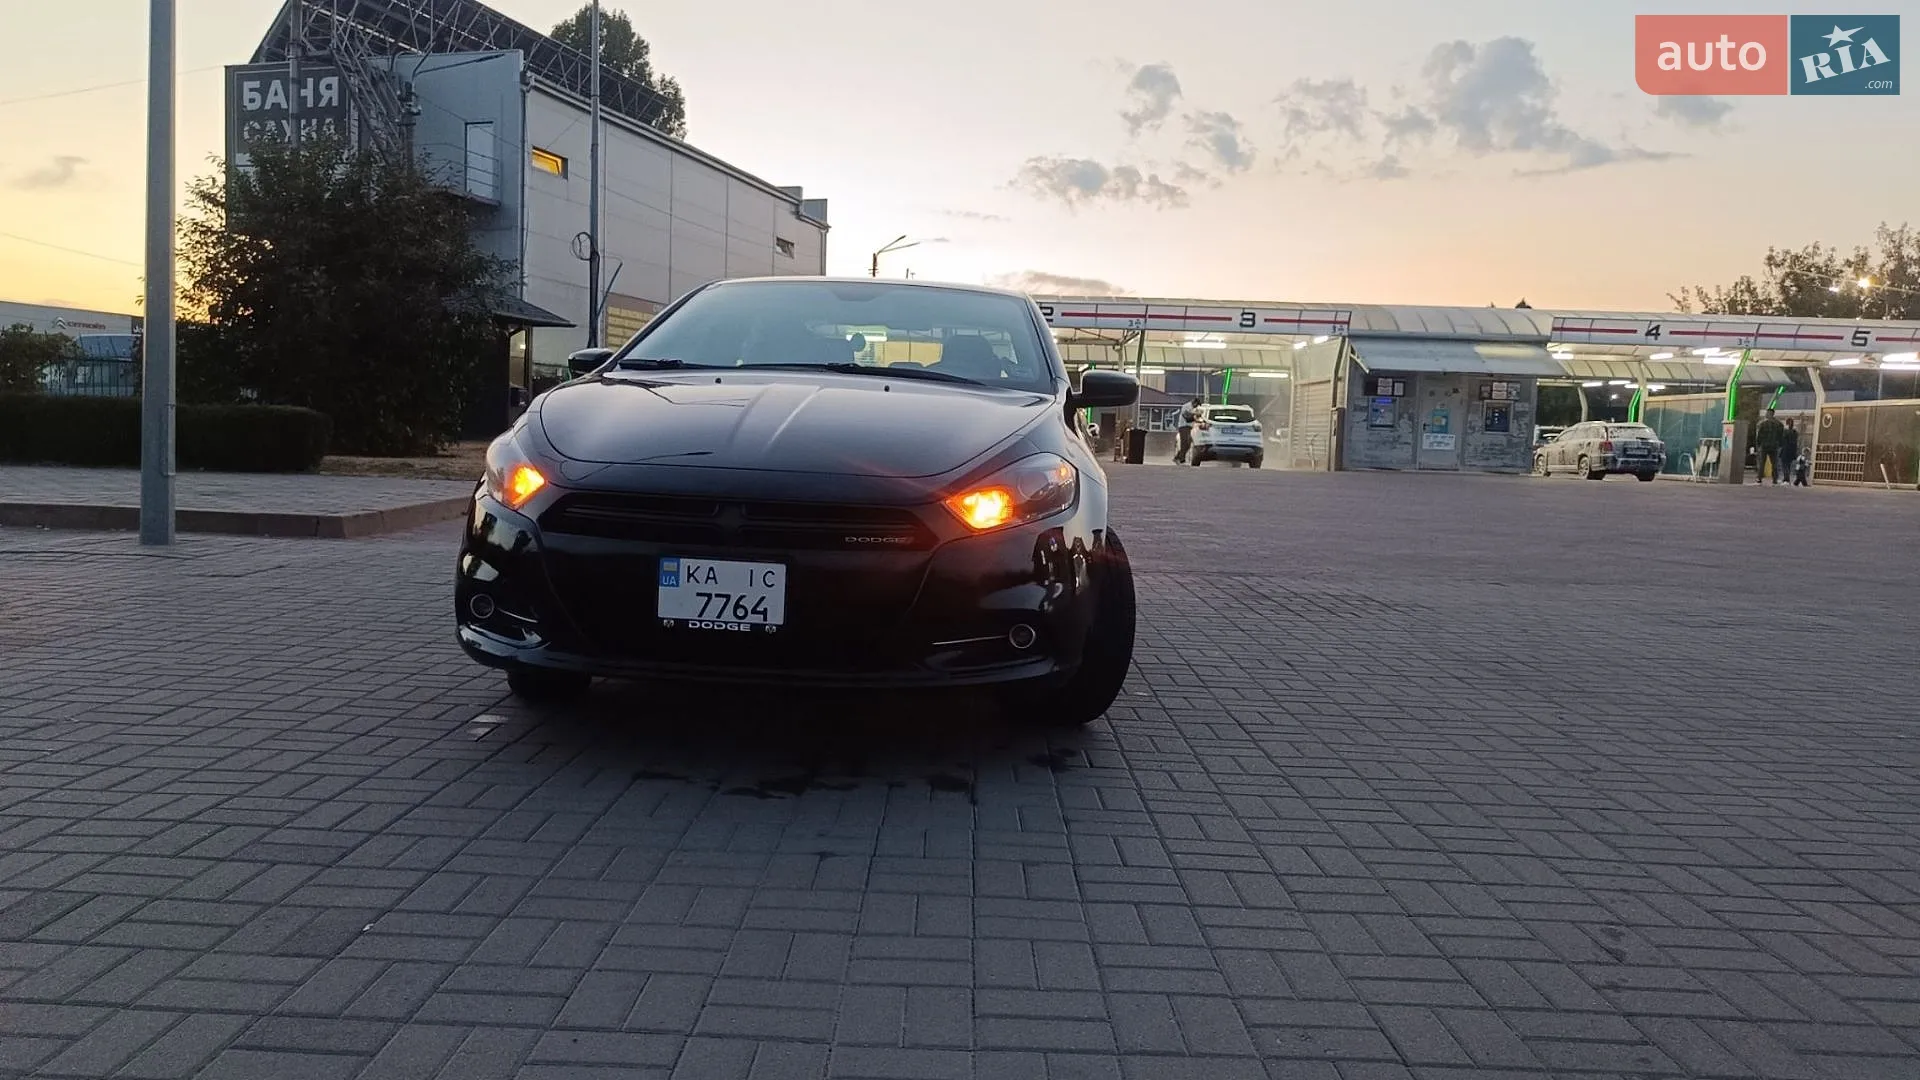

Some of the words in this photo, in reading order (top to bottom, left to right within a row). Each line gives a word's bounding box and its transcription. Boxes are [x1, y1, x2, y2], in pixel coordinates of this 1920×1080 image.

[243, 76, 339, 110] БАНЯ
[1041, 306, 1055, 322] 2
[1240, 312, 1257, 328] 3
[1645, 323, 1662, 340] 4
[1850, 330, 1871, 347] 5
[662, 575, 677, 585] UA
[686, 565, 718, 584] KA
[749, 569, 775, 588] IC
[695, 592, 768, 622] 7764
[688, 620, 751, 631] DODGE
